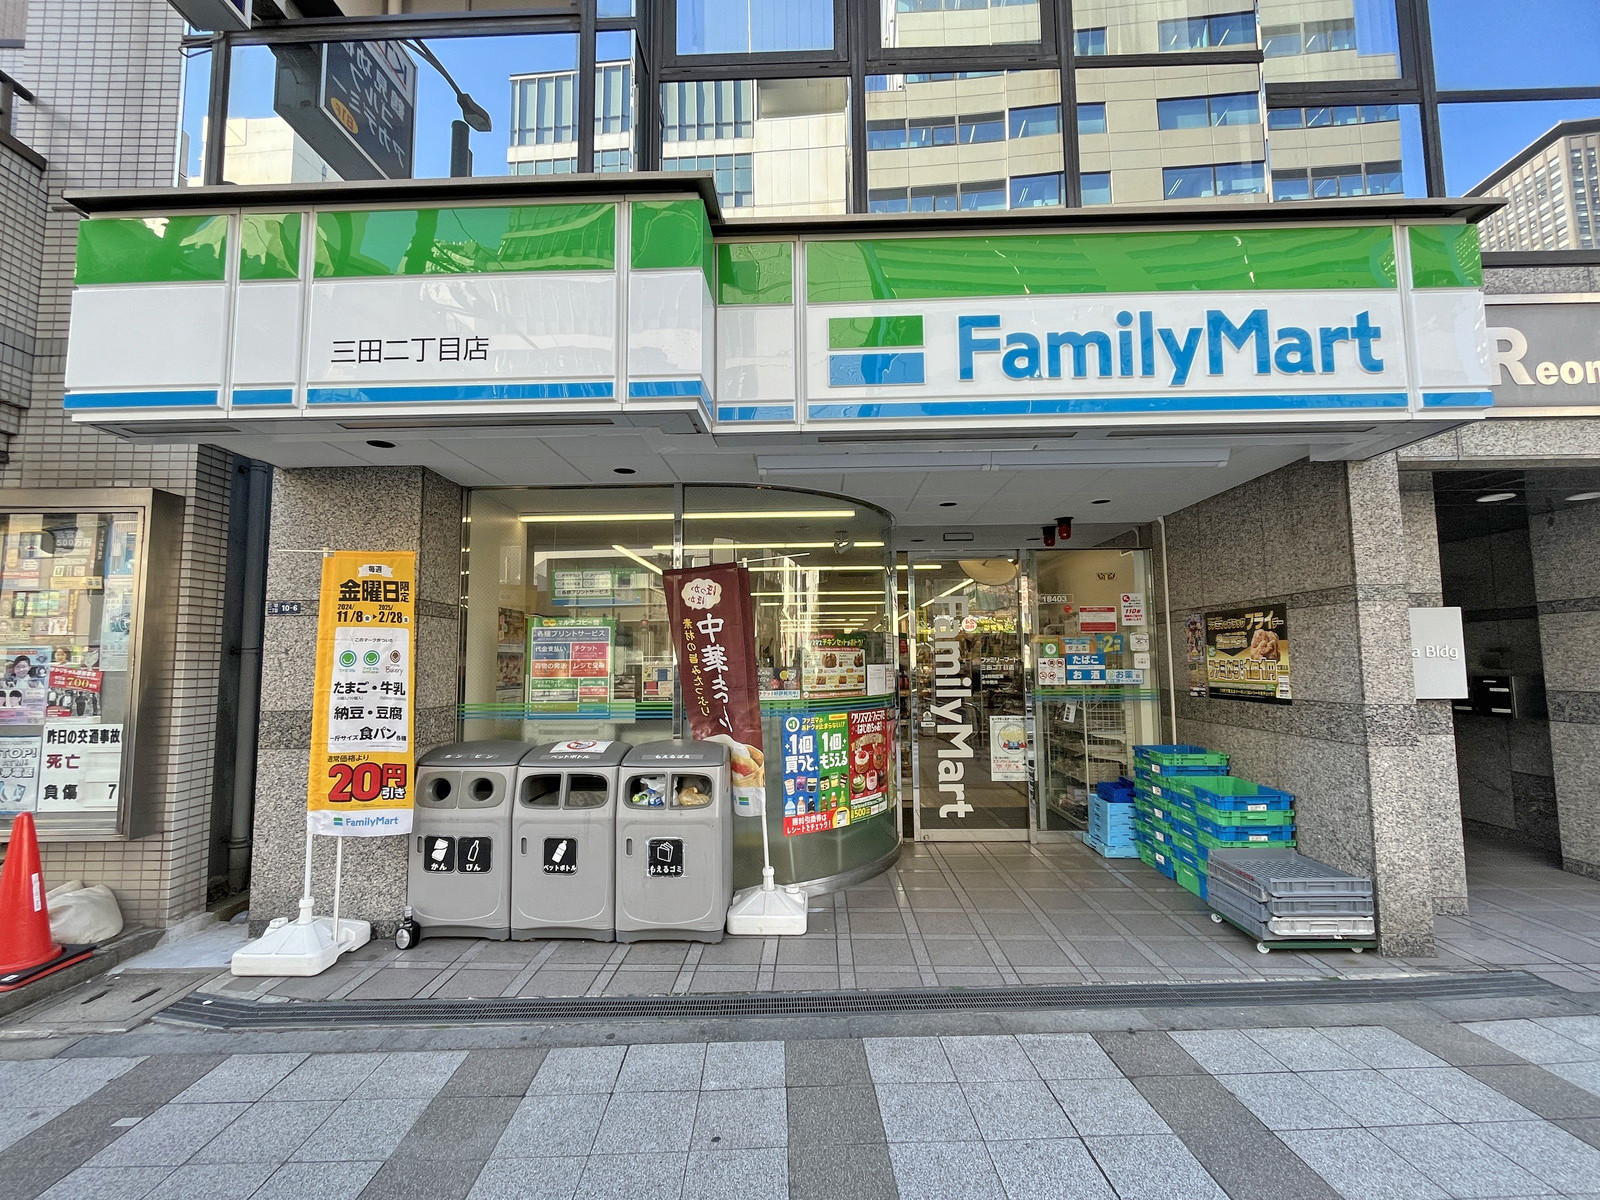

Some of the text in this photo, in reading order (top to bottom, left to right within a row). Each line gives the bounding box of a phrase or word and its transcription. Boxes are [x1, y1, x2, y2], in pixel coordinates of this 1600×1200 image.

[330, 335, 490, 365] 三田二丁目店
[957, 309, 1384, 388] FamilyMart
[368, 566, 382, 574] 毎週
[1073, 655, 1099, 664] たばこ
[1425, 645, 1458, 661] Bldg
[333, 681, 406, 695] たまご・牛乳
[334, 706, 402, 720] 納豆・豆腐
[930, 595, 974, 818] FamilyMart
[47, 729, 121, 745] 昨日の交通事故
[0, 748, 37, 758] TOP!
[46, 754, 80, 769] 死亡
[44, 784, 78, 800] 負傷
[108, 784, 117, 800] 7
[346, 817, 398, 827] FamilyMart
[430, 862, 481, 871] かん びん
[650, 865, 682, 874] もえるゴミ
